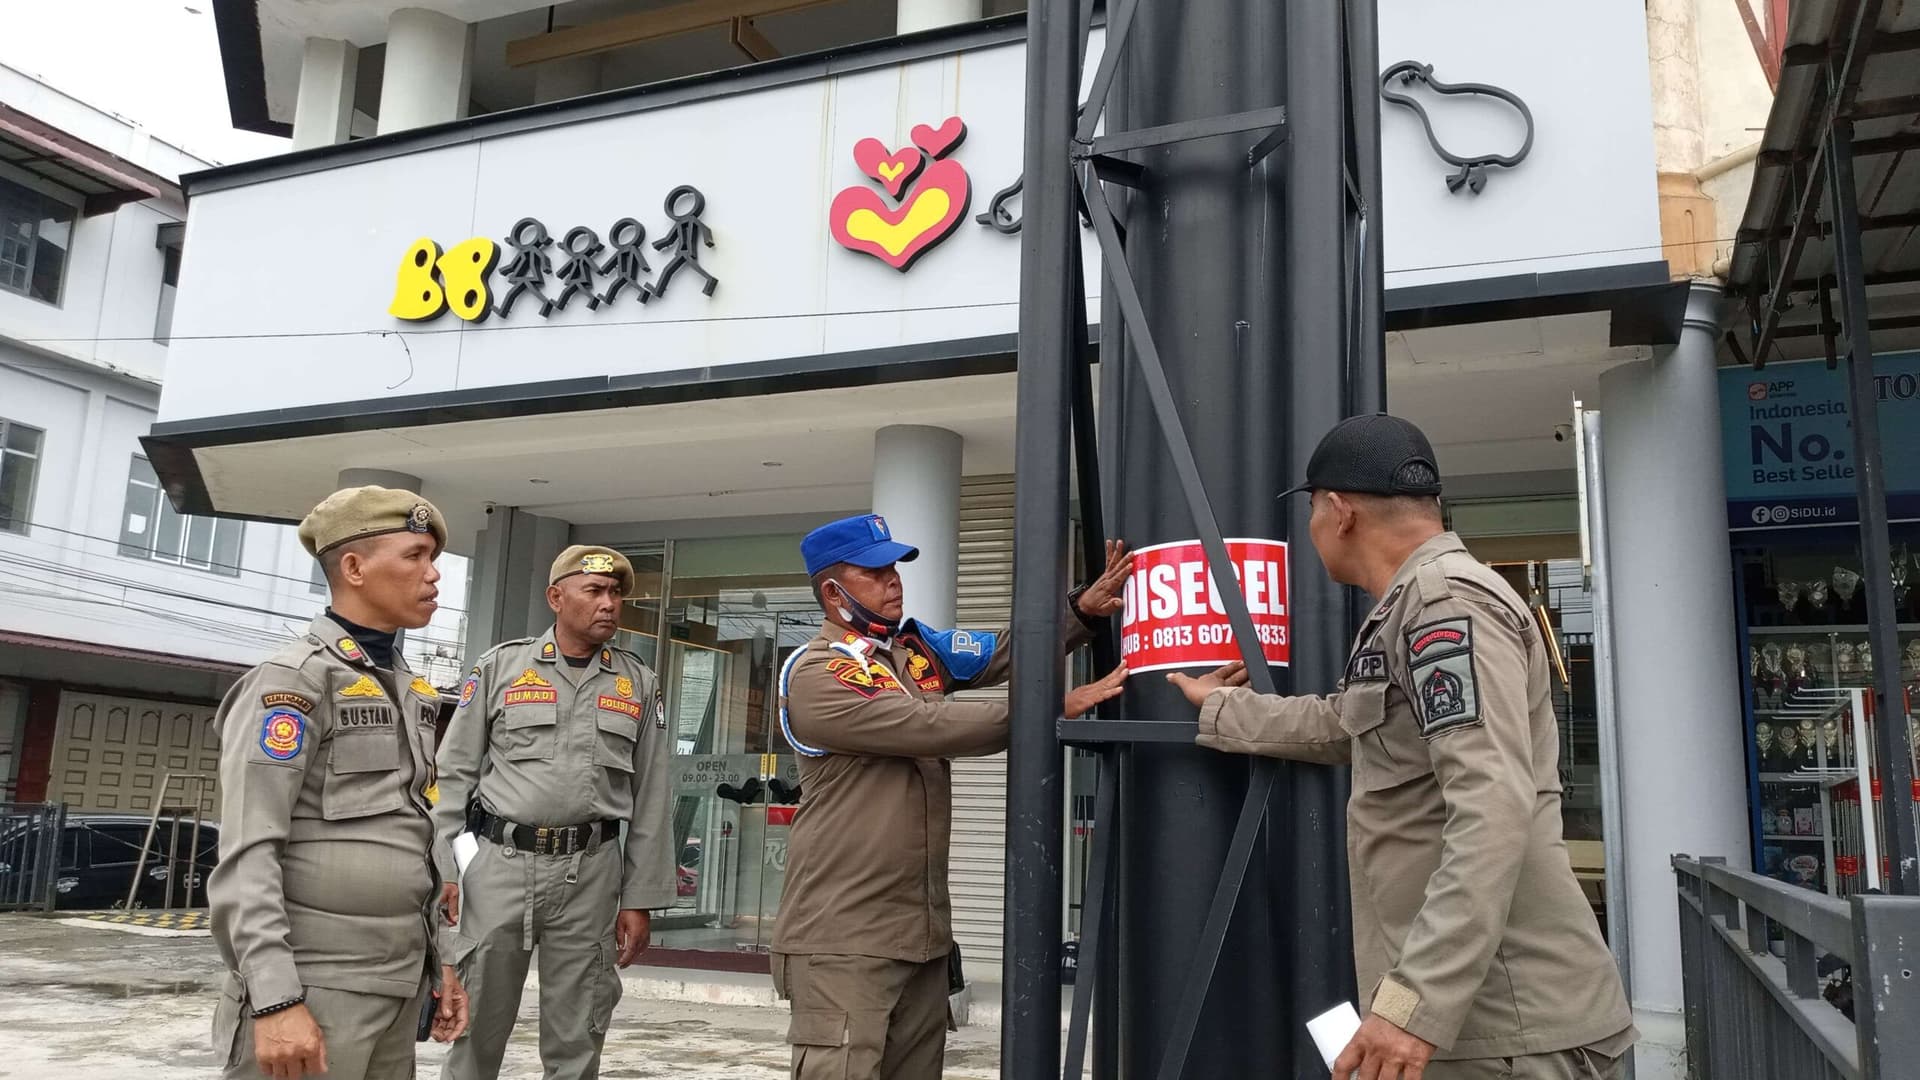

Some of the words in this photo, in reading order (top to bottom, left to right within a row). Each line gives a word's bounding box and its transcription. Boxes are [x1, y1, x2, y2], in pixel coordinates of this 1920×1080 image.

[1769, 381, 1794, 392] APP
[1872, 373, 1920, 401] TO
[1749, 400, 1848, 420] Indonesia
[1751, 422, 1845, 465] No.
[1753, 468, 1797, 484] Best
[1802, 464, 1856, 481] Selle
[1152, 625, 1193, 649] 0813
[507, 690, 554, 703] JUMADI
[600, 697, 629, 712] POLISI
[696, 761, 727, 772] OPEN
[682, 774, 707, 783] 09.00
